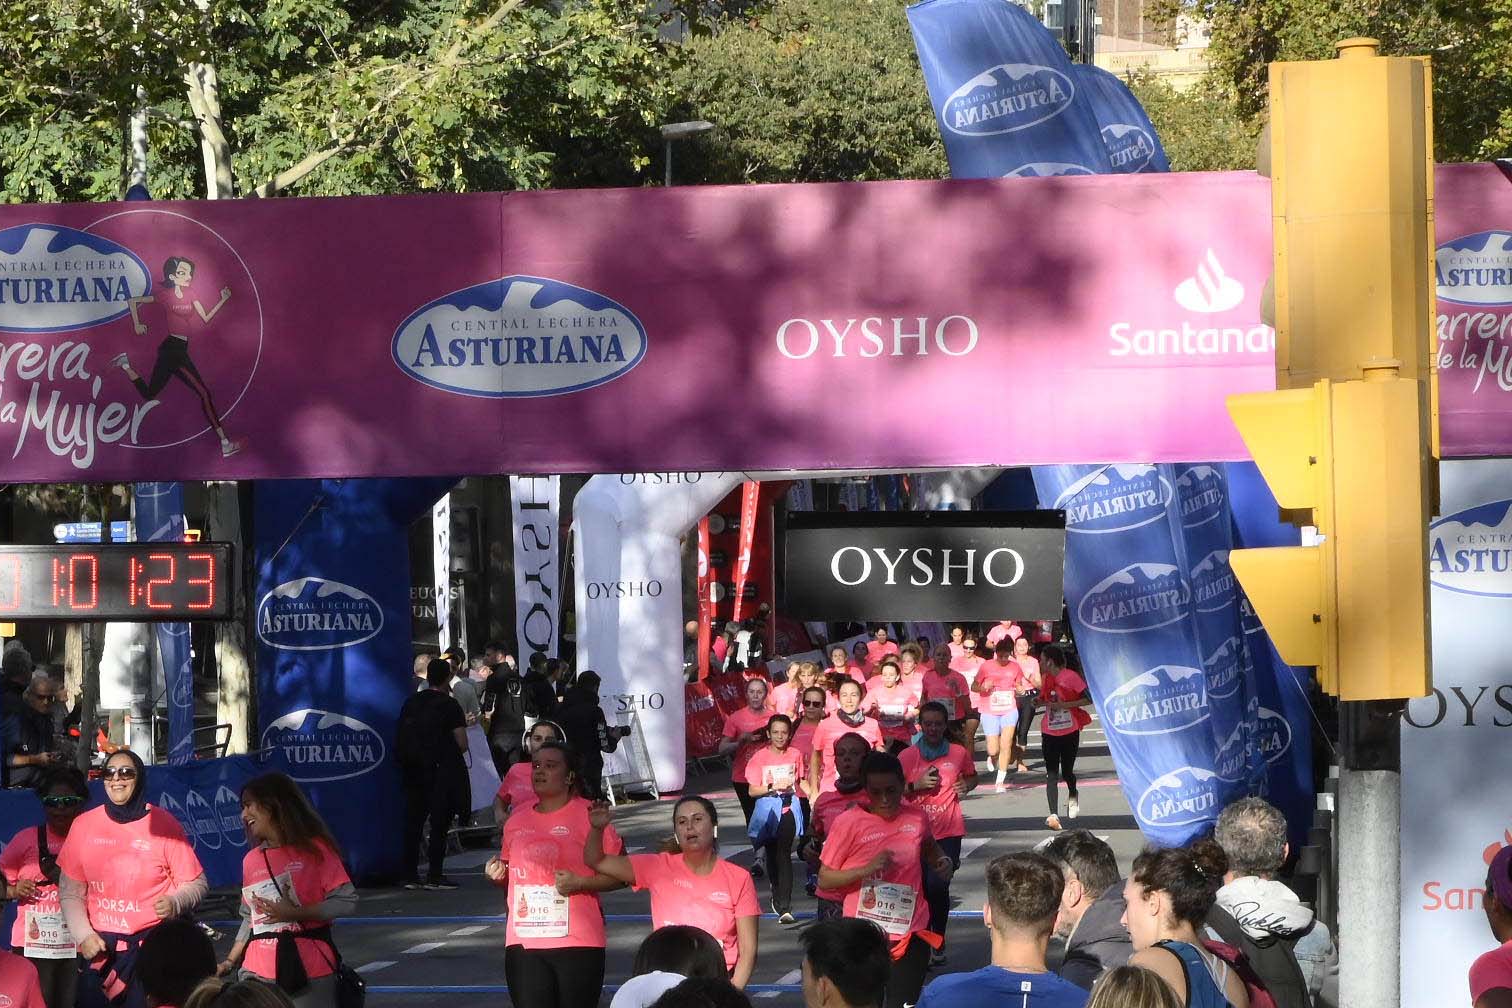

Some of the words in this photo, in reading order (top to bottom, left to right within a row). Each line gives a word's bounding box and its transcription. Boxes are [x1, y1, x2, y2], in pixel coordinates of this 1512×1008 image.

[54, 259, 126, 271] LECHERA
[451, 318, 529, 331] CENTRAL
[538, 316, 618, 329] LECHERA
[411, 323, 627, 367] ASTURIANA
[775, 314, 979, 360] OYSHO
[1459, 342, 1477, 369] la
[12, 375, 160, 469] Mujer
[831, 545, 1025, 589] OYSHO
[587, 580, 662, 600] OYSHO
[261, 606, 374, 634] ASTURIANA
[91, 880, 105, 893] TU
[877, 900, 896, 910] 016
[40, 930, 58, 938] 016
